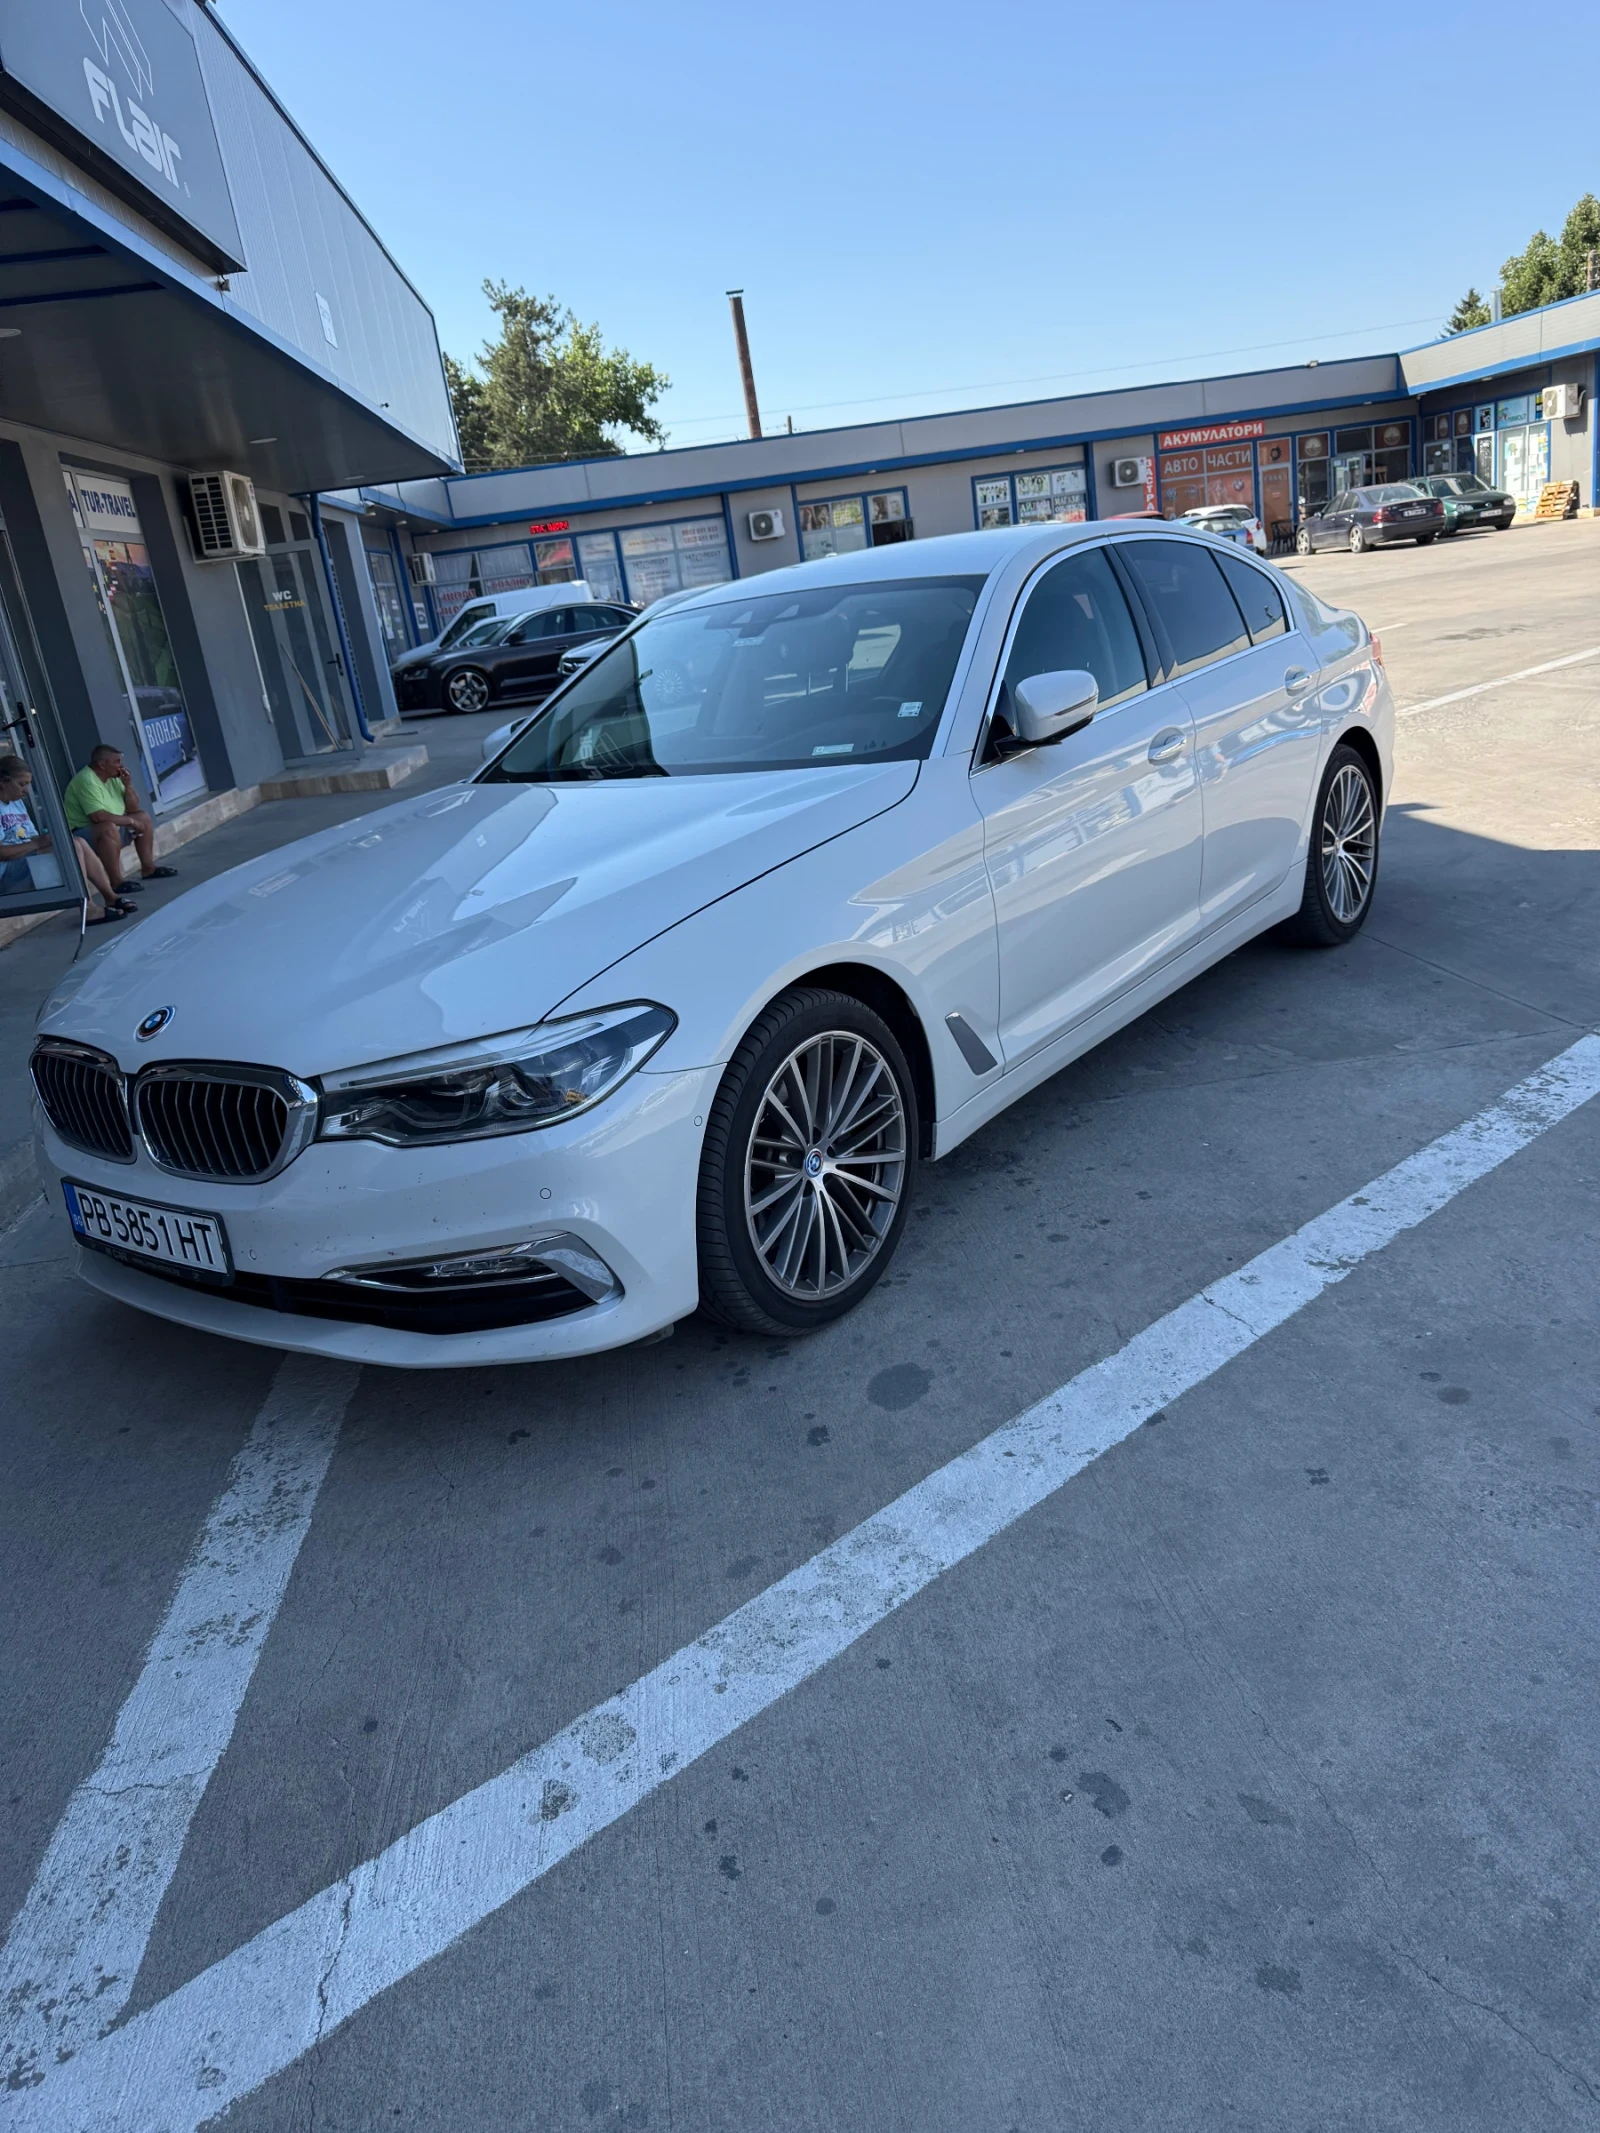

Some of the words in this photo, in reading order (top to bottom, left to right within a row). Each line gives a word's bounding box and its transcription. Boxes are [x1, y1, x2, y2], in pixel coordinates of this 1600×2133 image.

[1163, 423, 1263, 447] АКУМУЛАТОРИ
[1164, 457, 1198, 474] АВТО
[1207, 450, 1251, 467] ЧАСТИ
[80, 489, 136, 518] TUR-TRAVEL
[272, 590, 292, 601] WC
[145, 715, 182, 749] BIOHAS
